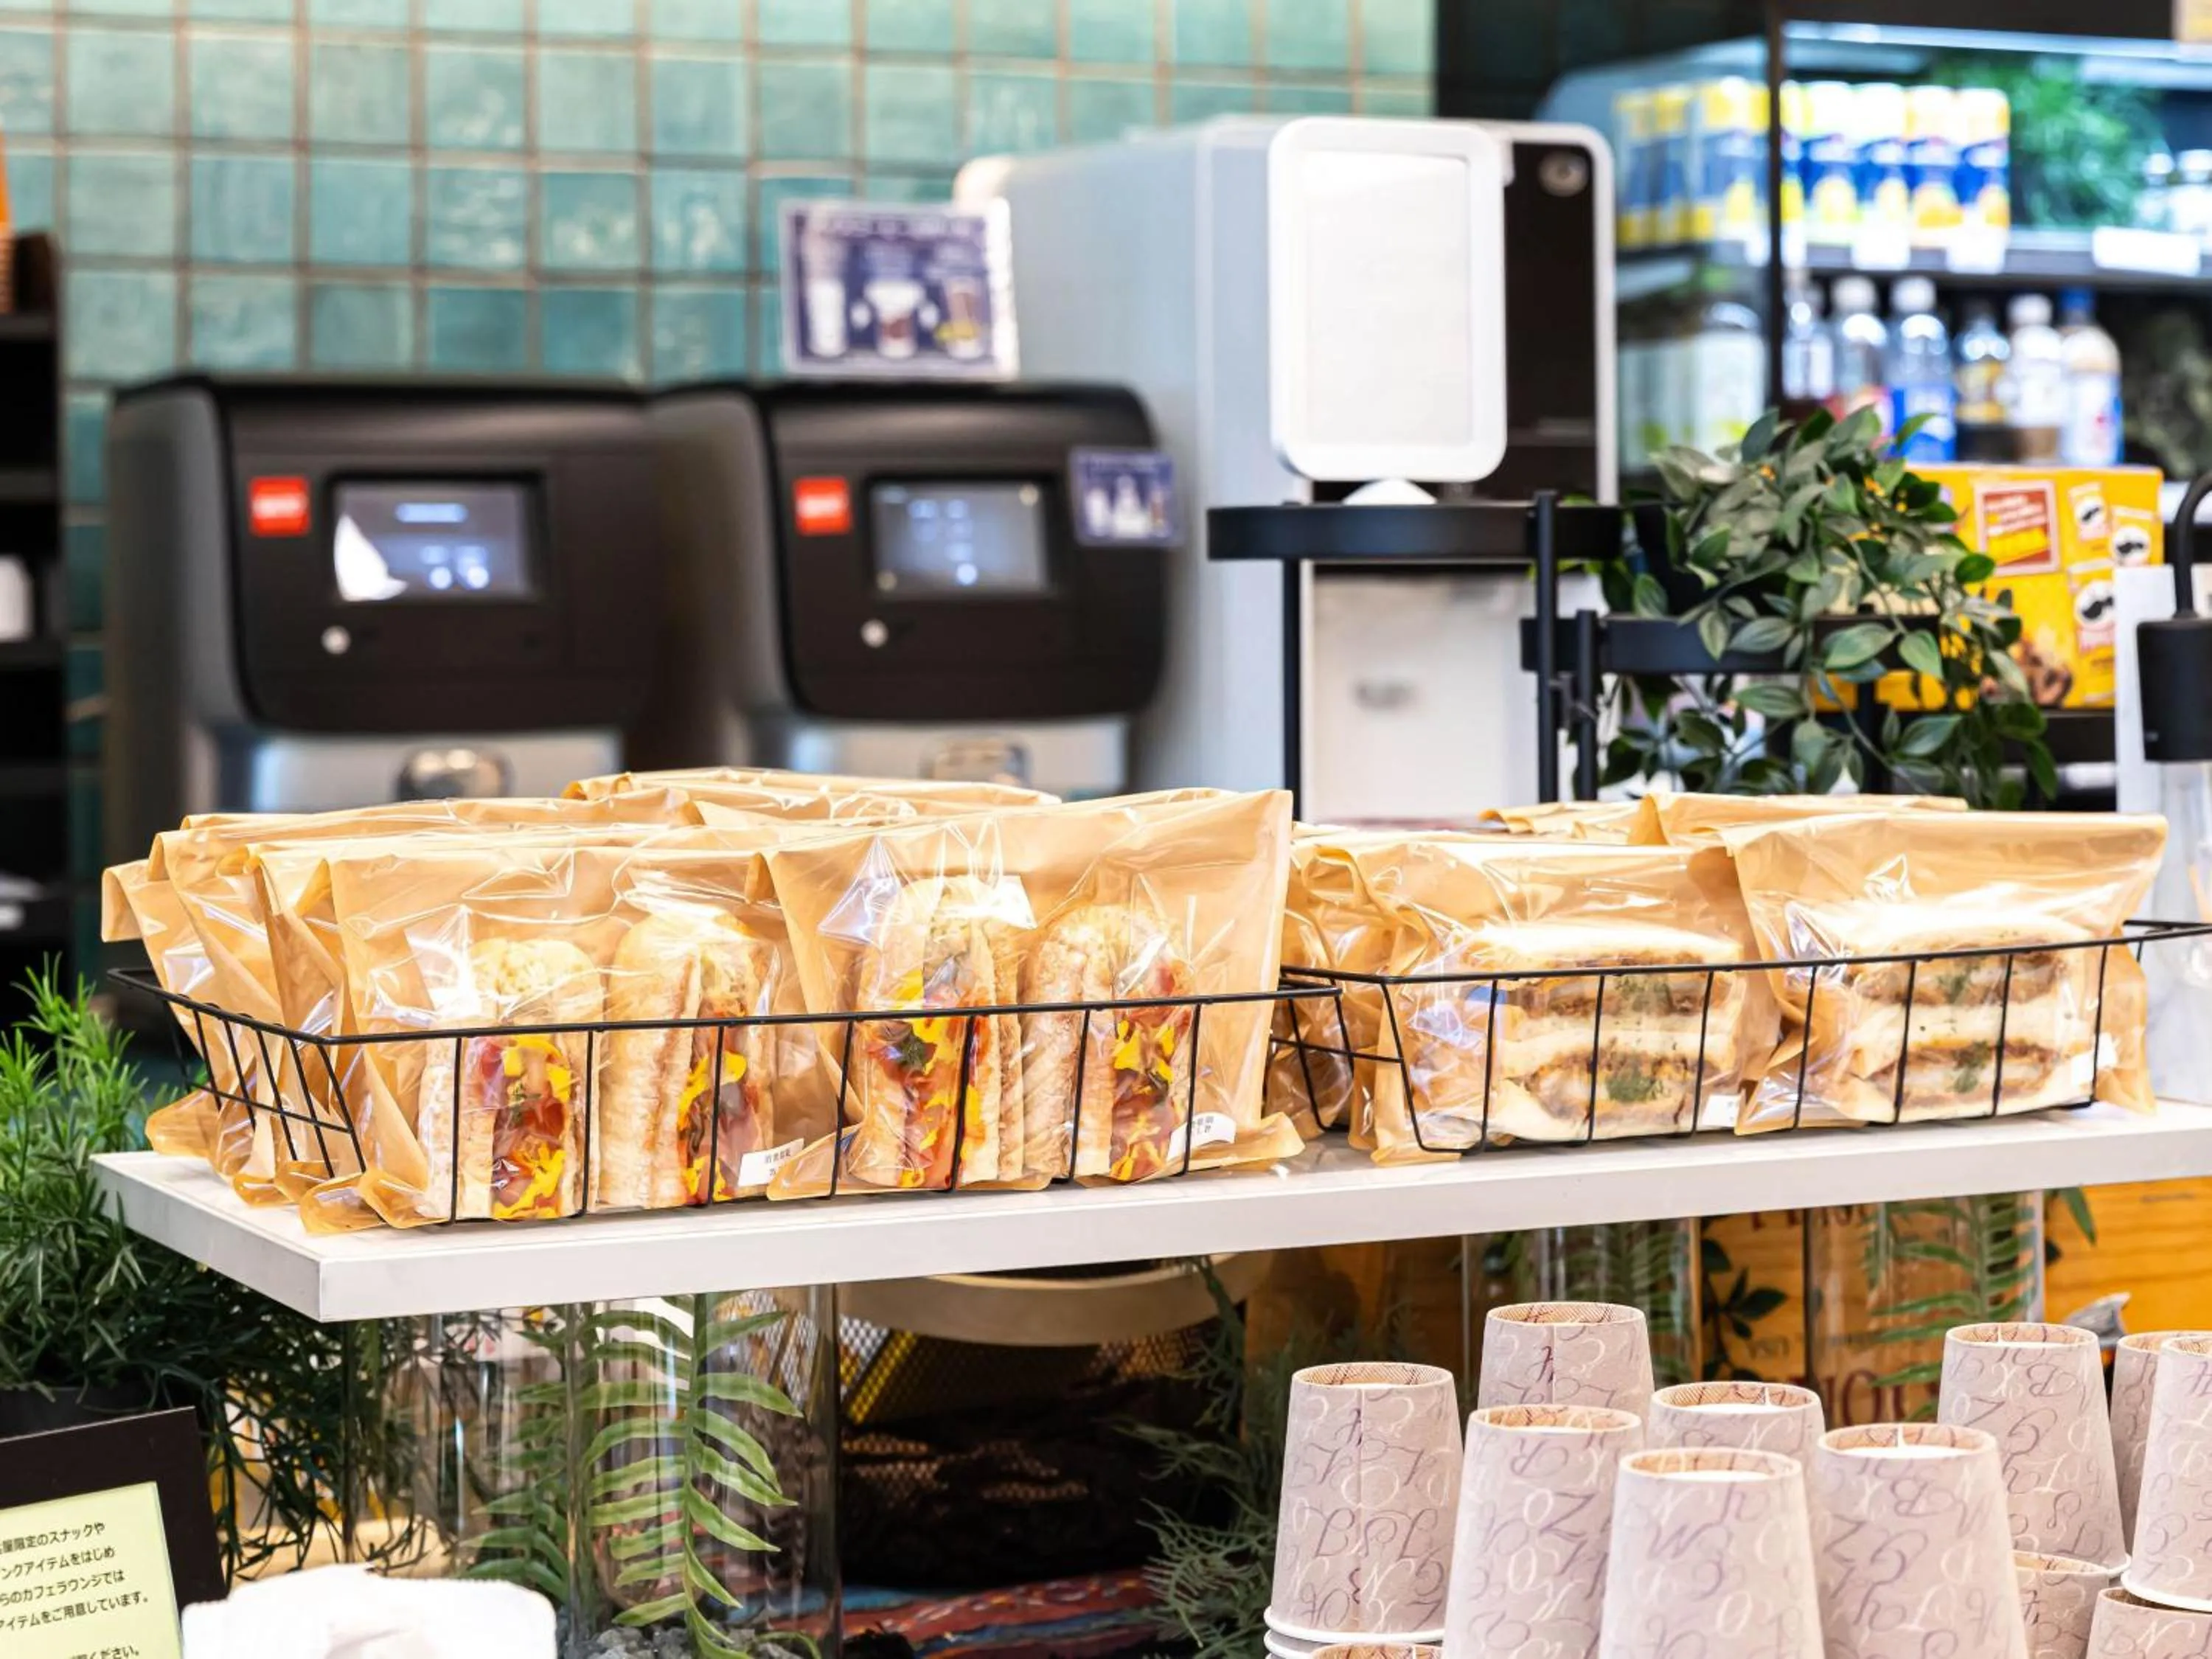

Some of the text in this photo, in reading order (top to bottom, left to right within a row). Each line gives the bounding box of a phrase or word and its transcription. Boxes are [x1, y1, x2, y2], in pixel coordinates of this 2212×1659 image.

[0, 1523, 105, 1554] 屋限定のスナックや
